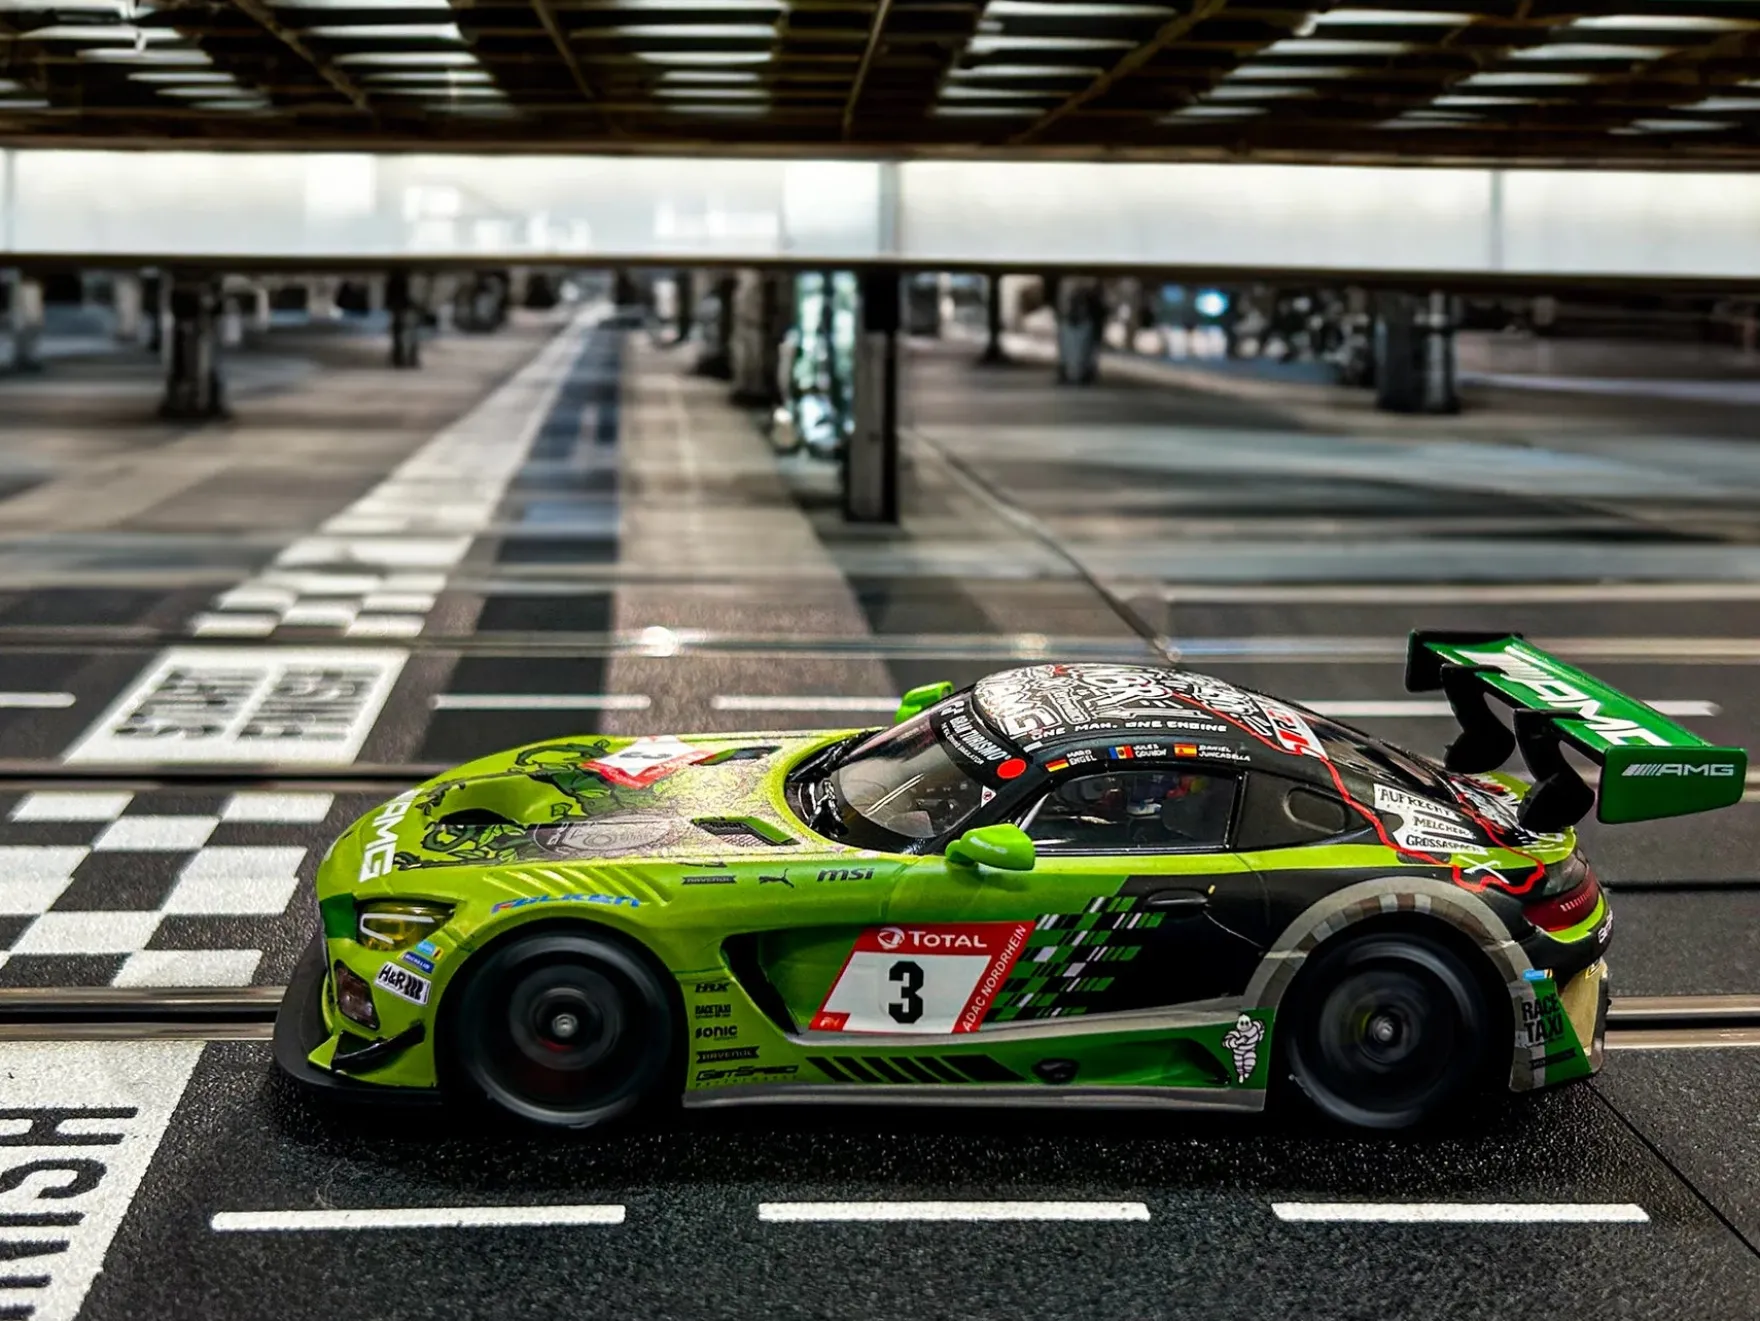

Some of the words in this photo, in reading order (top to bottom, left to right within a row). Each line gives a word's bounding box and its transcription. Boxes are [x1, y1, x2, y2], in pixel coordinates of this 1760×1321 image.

[1126, 720, 1162, 728] ONE
[1167, 721, 1227, 732] ENGINE
[1654, 763, 1735, 777] AMG
[817, 867, 876, 882] msi
[908, 930, 988, 948] TOTAL
[962, 995, 986, 1033] ADAC
[981, 924, 1027, 997] NORDRHEIN
[888, 960, 924, 1024] 3
[1522, 993, 1560, 1021] RACE
[1524, 1012, 1565, 1045] TAXI
